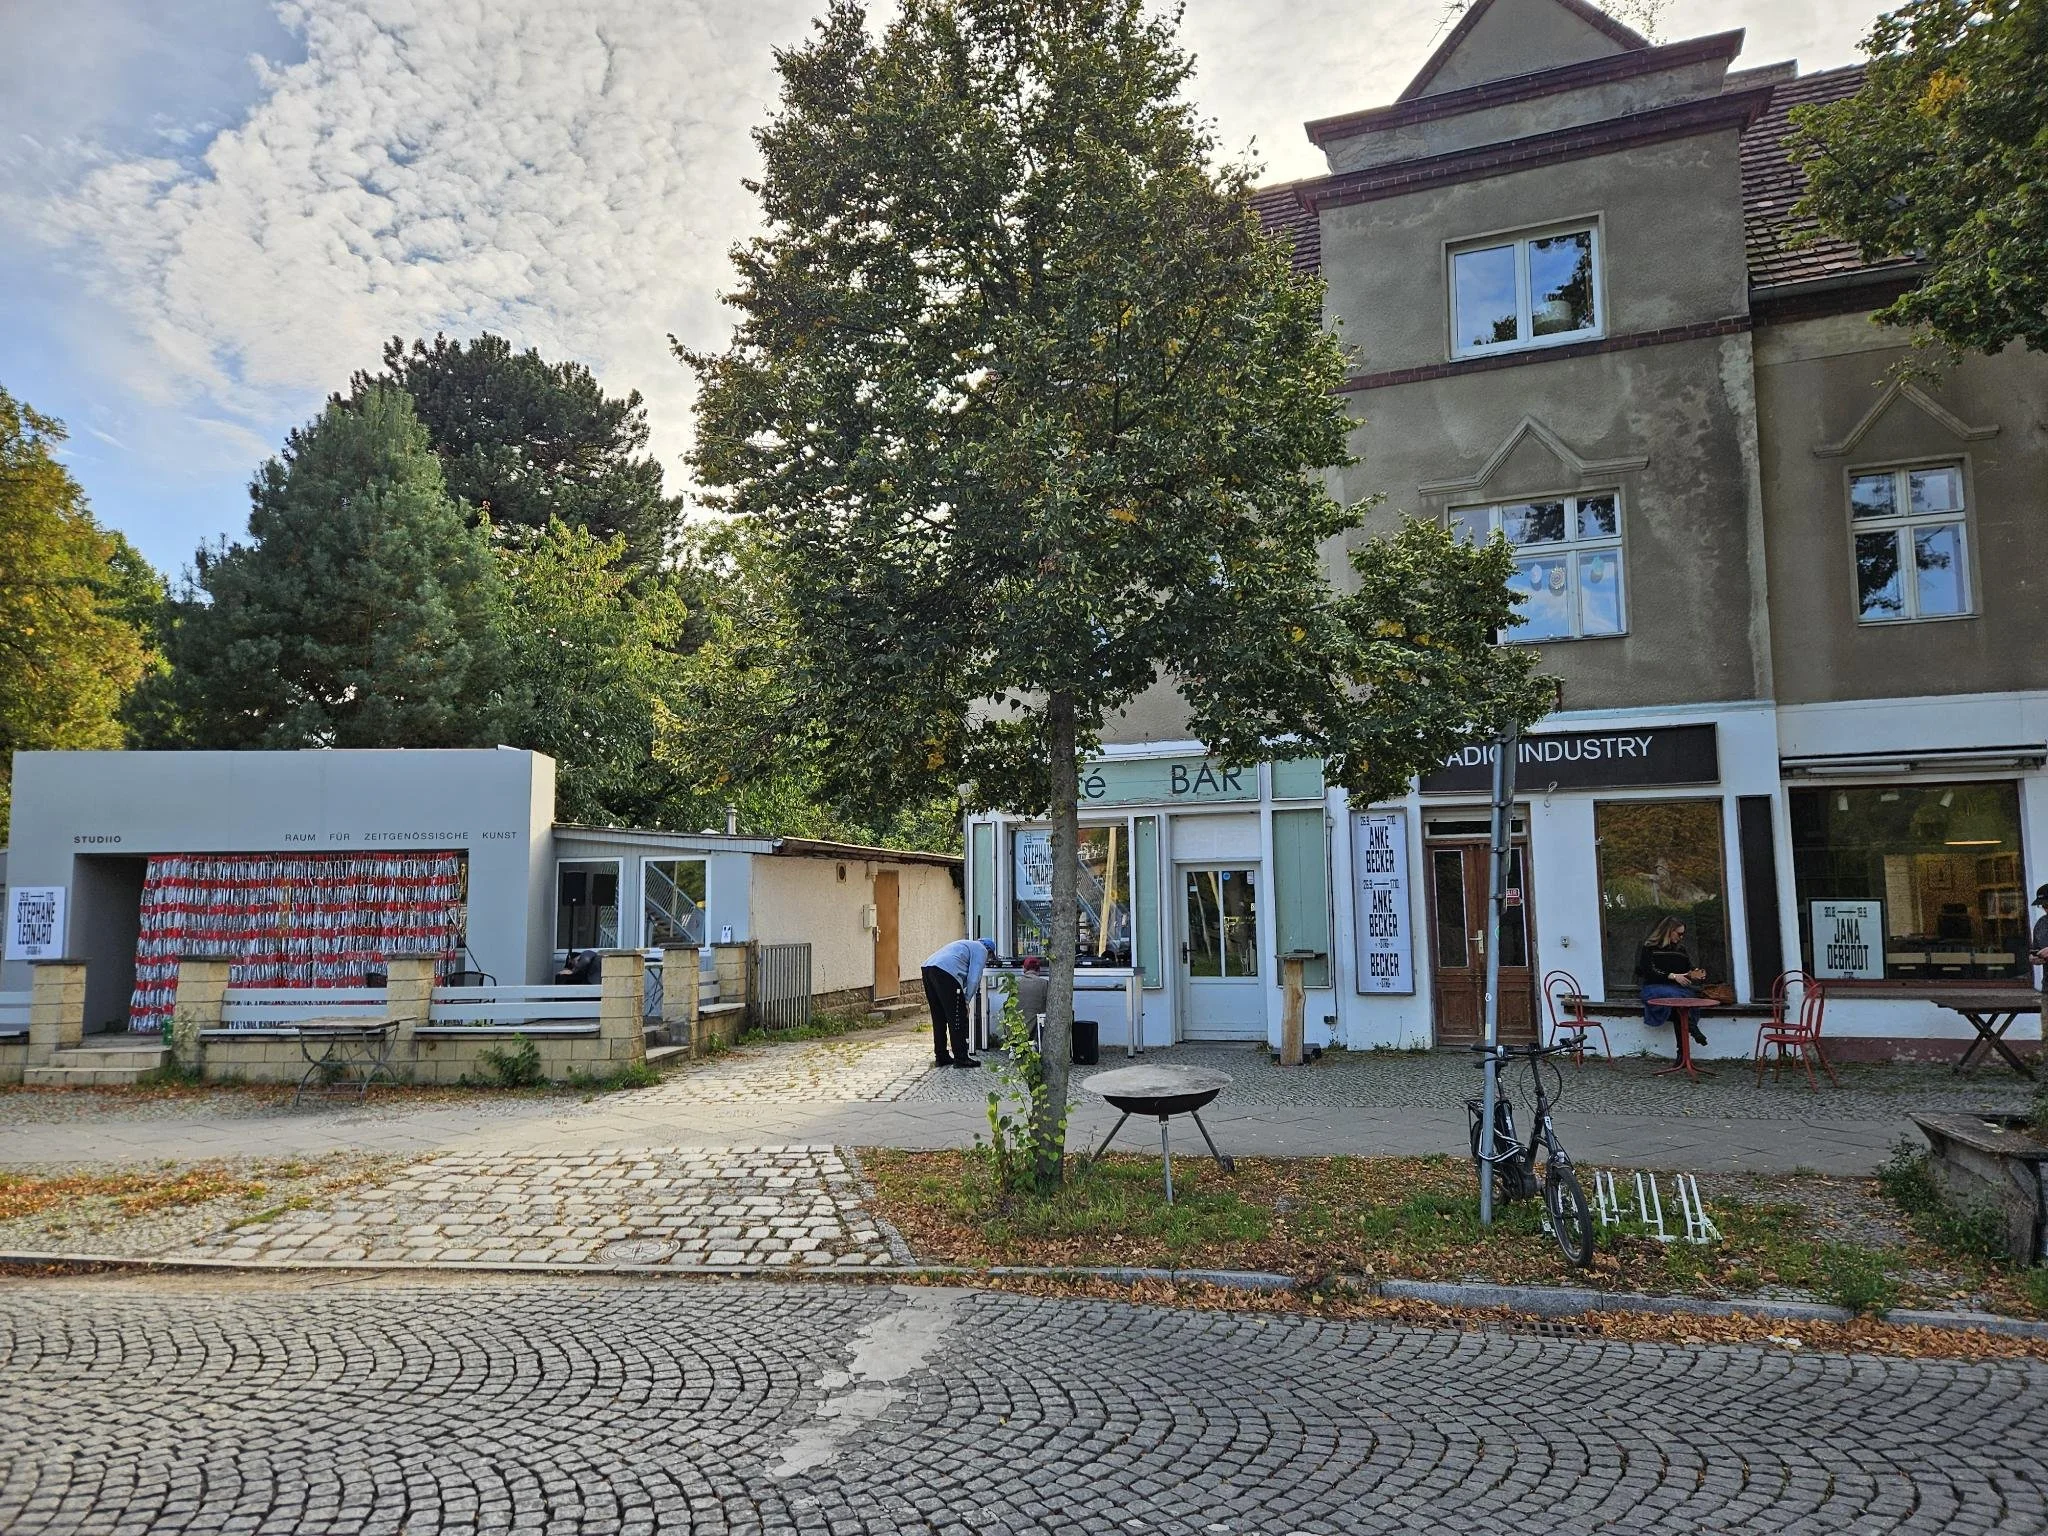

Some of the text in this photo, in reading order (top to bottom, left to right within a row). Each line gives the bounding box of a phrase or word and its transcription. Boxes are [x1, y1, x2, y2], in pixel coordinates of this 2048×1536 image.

[1519, 736, 1653, 763] INDUSTRY
[1171, 762, 1242, 794] BAR
[74, 835, 121, 844] STUDIIO
[285, 831, 517, 841] RAUM FÜR ZEITGENÖSSISCHE KUNST
[1369, 826, 1389, 849] ANKE
[1023, 844, 1053, 865] STEPHAN
[1366, 850, 1395, 873] BECKER
[17, 902, 55, 923] STEPHANE
[1372, 889, 1393, 913] ANKE
[18, 924, 52, 945] LEONARD
[1369, 914, 1398, 937] BECKER
[1834, 918, 1861, 944] JANA
[1370, 953, 1400, 977] BECKER
